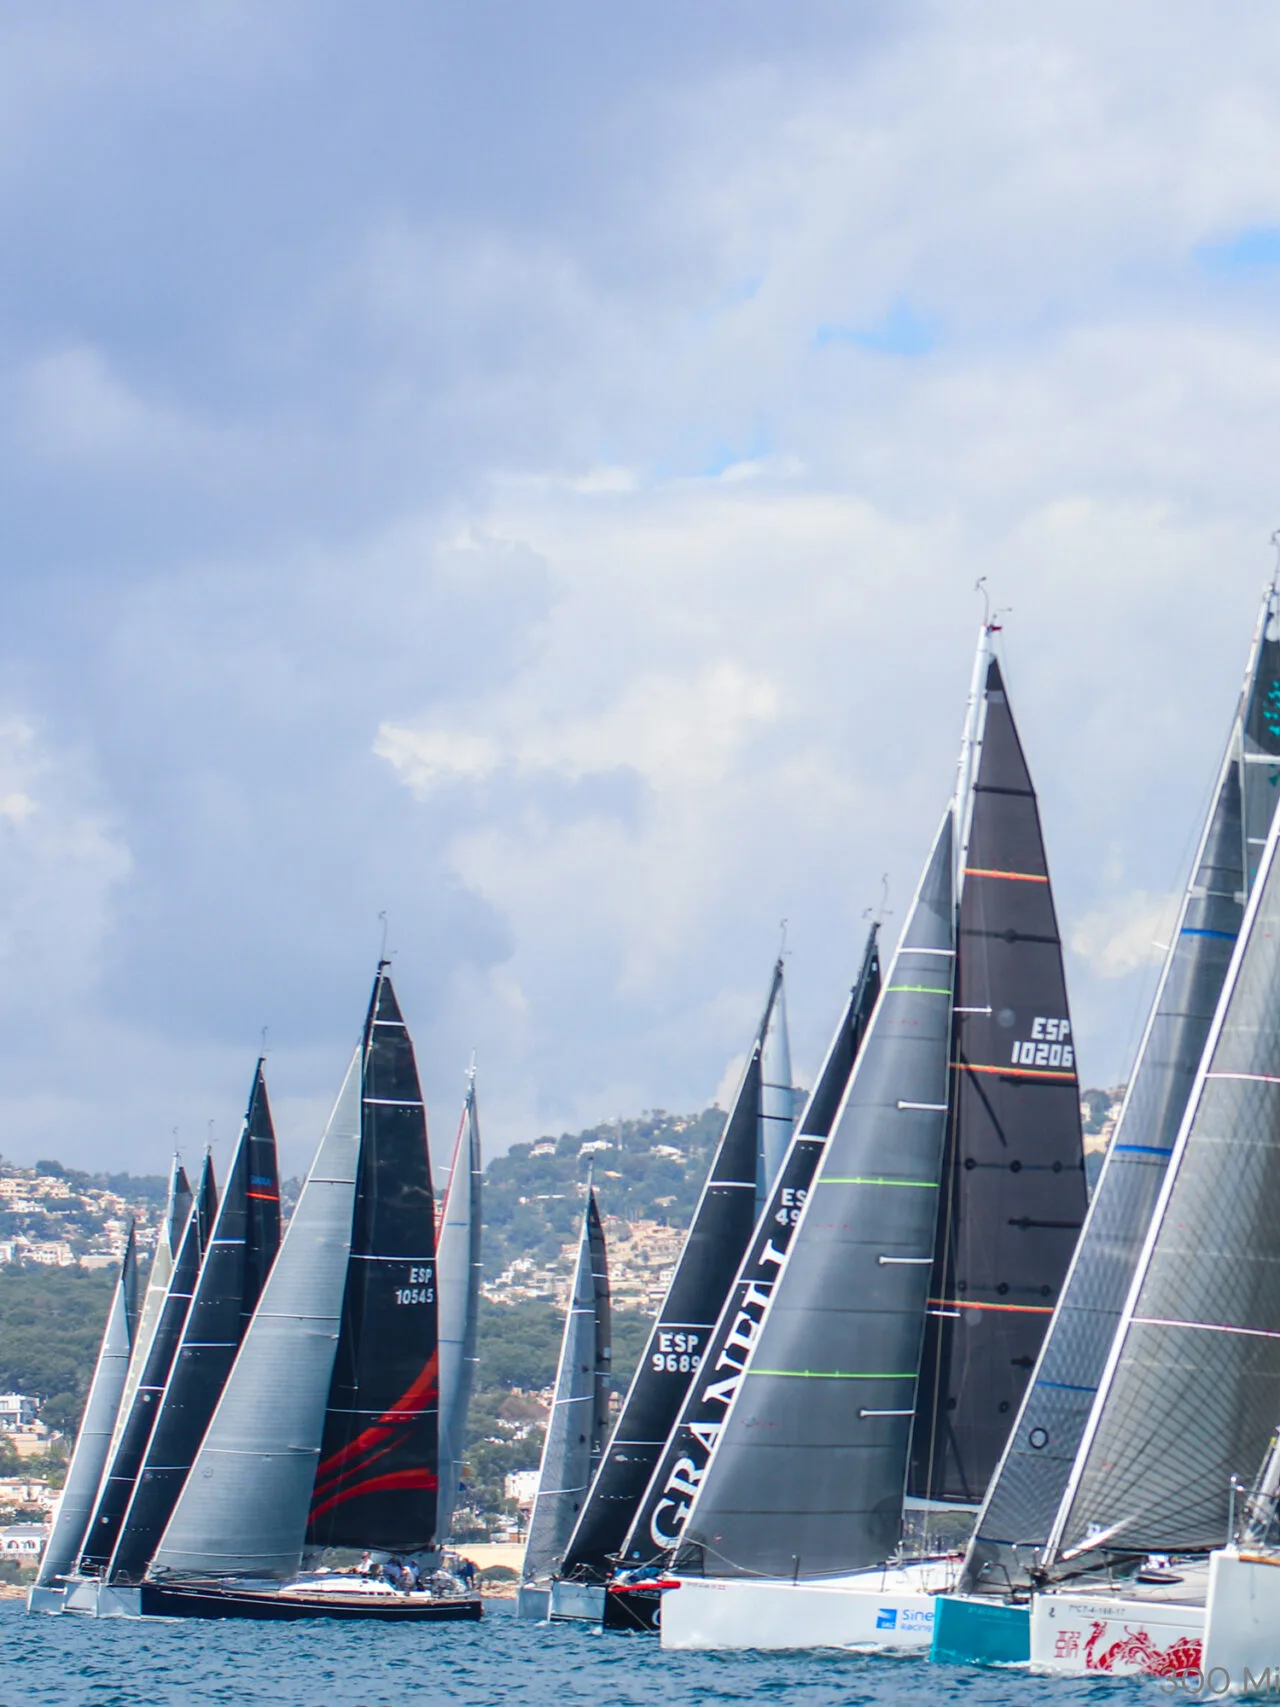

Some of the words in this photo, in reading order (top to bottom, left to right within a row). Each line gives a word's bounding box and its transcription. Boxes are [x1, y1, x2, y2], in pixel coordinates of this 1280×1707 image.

[1031, 1017, 1071, 1041] ESP
[1011, 1040, 1073, 1067] 10206
[409, 1267, 433, 1284] ESP
[395, 1288, 434, 1305] 10545
[659, 1333, 699, 1353] ESP
[652, 1353, 701, 1372] 9689
